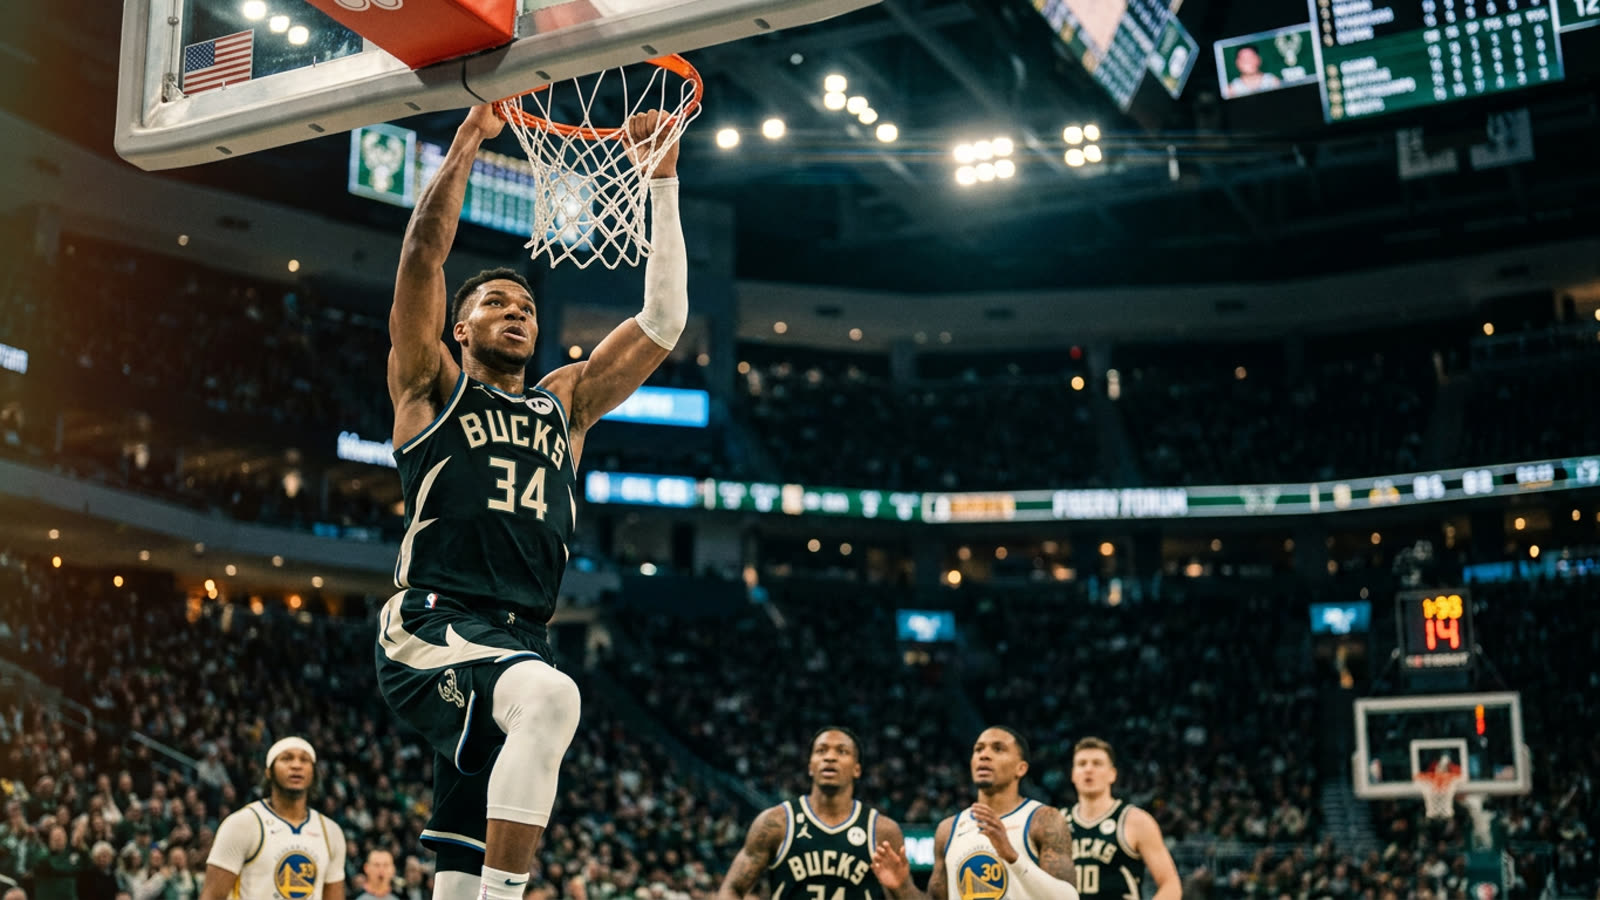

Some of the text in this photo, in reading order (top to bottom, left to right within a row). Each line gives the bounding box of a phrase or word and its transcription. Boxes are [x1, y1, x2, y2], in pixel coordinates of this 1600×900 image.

[459, 409, 566, 470] BUCKS
[487, 456, 547, 520] 34
[1425, 619, 1460, 651] 14
[787, 850, 869, 885] BUCKS
[981, 863, 1002, 882] 30
